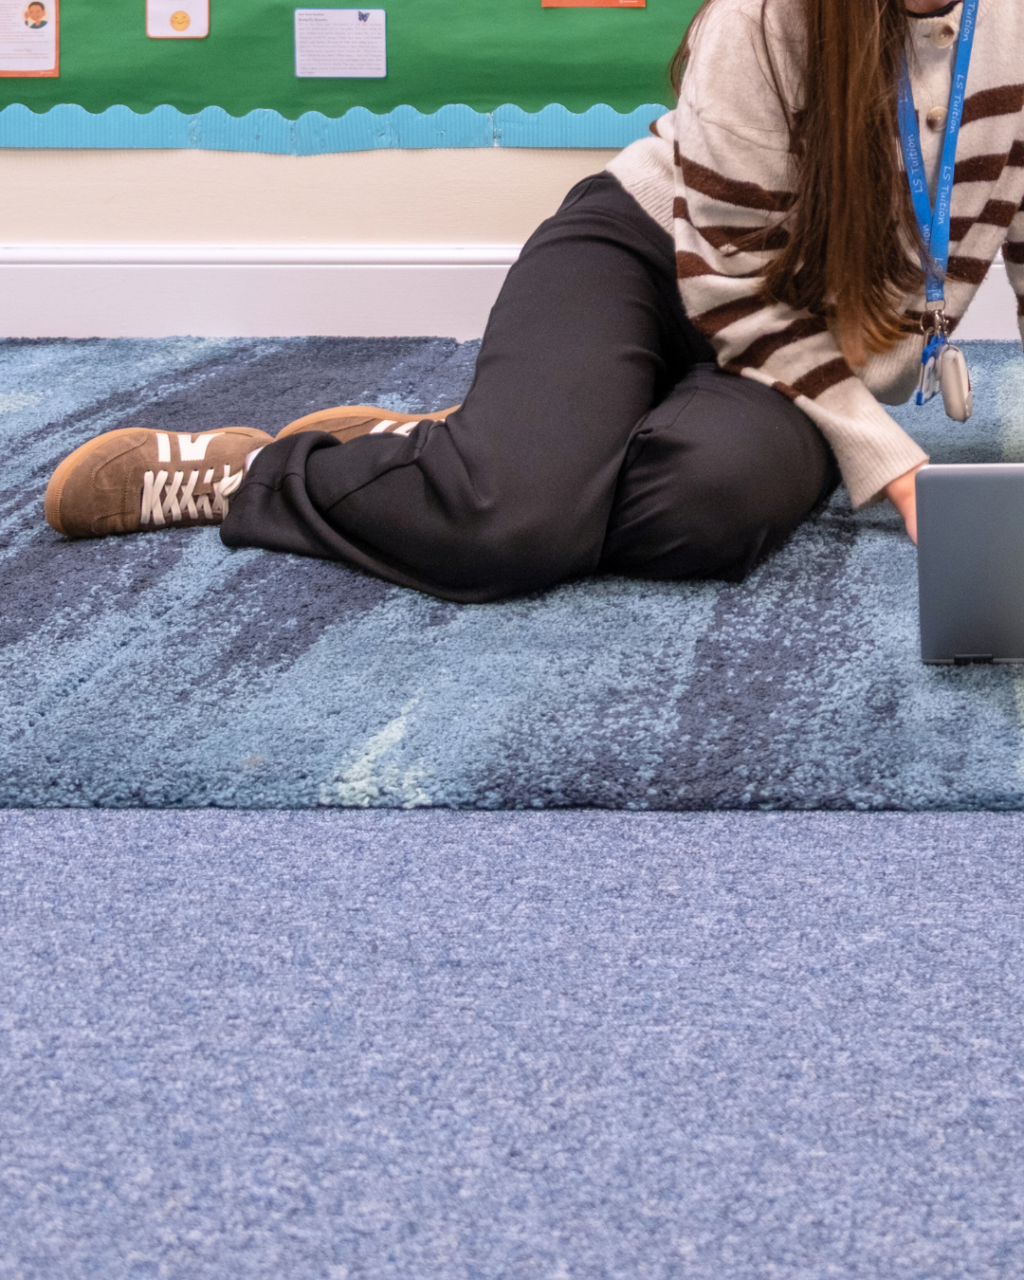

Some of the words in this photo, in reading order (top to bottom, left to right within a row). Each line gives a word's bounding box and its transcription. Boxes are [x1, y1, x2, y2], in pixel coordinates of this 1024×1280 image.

[963, 2, 975, 41] Tuition
[956, 74, 964, 89] LS
[950, 94, 962, 133] Tuition
[908, 134, 920, 174] Tuition
[943, 165, 951, 180] LS
[913, 180, 923, 193] LS
[938, 186, 949, 224] Tuition
